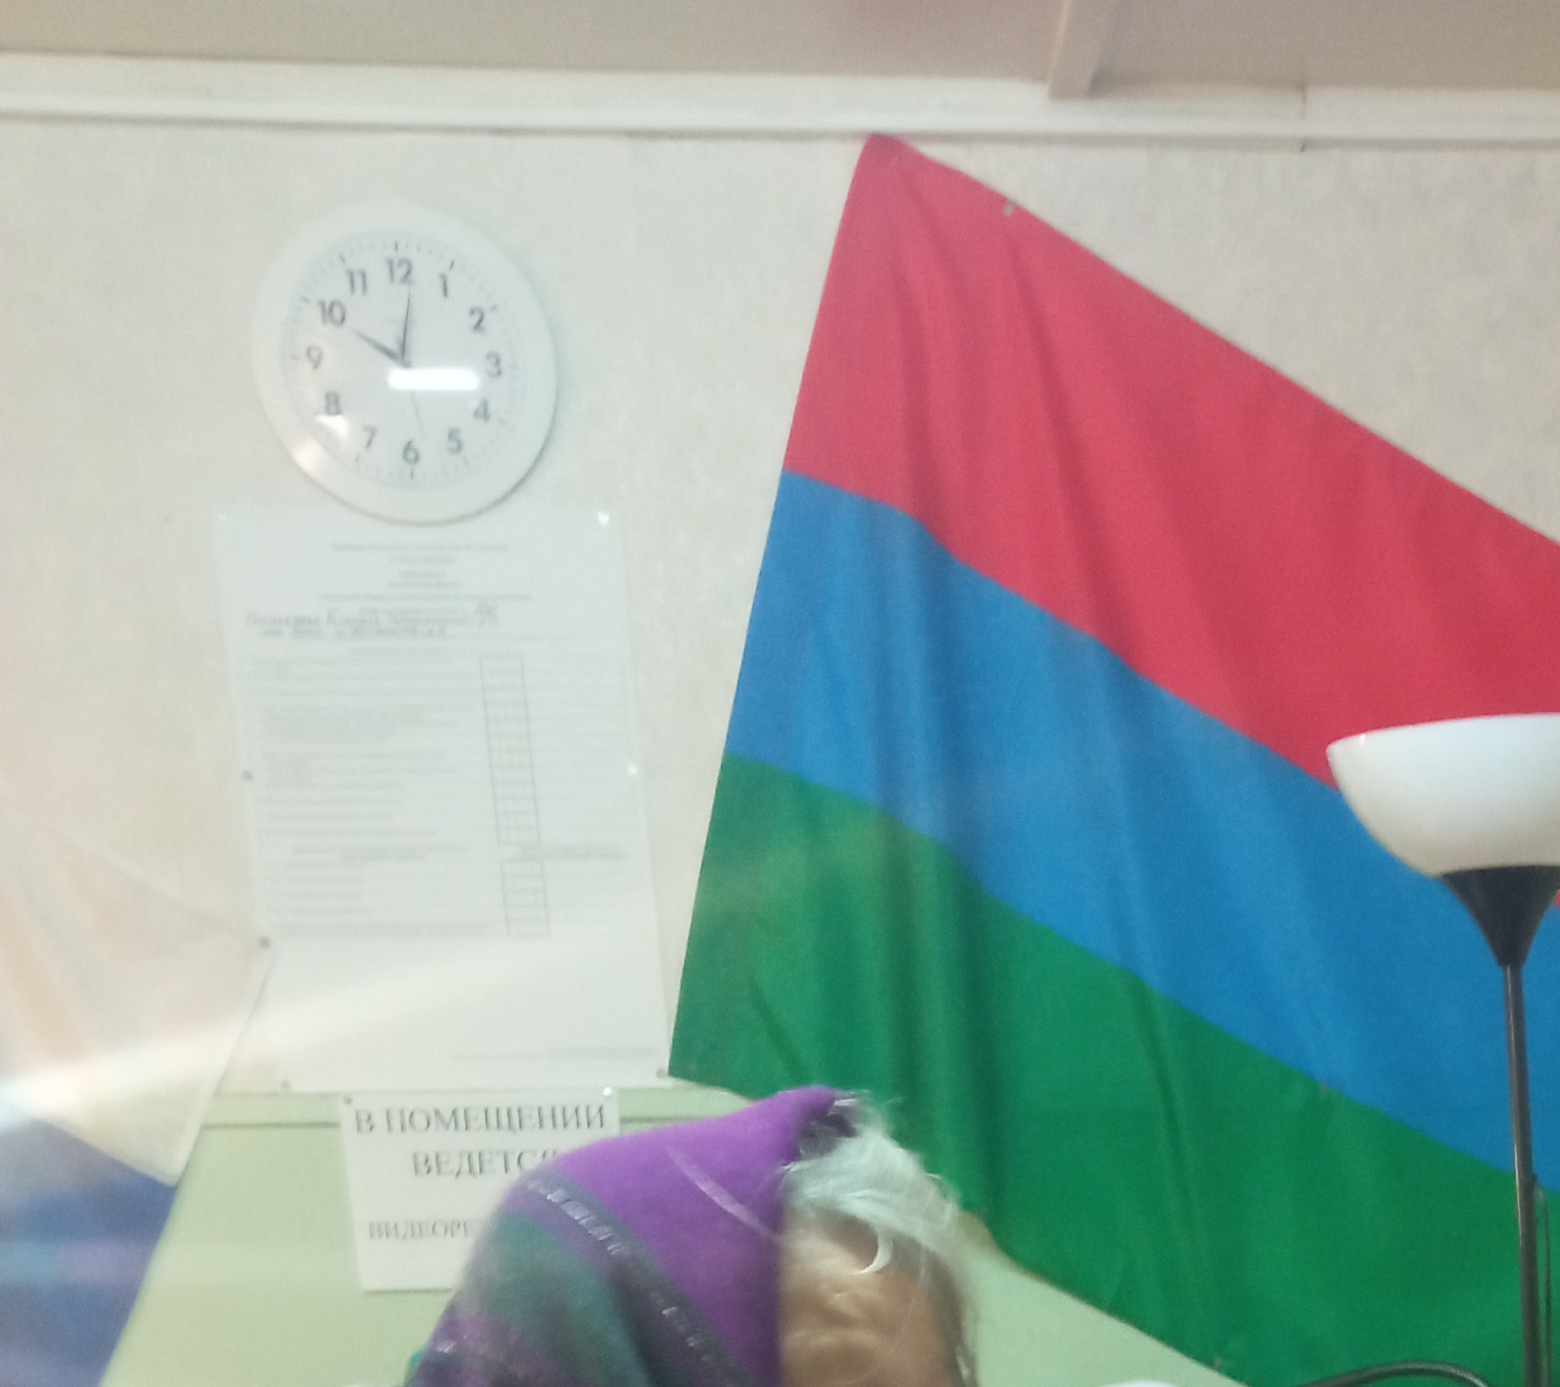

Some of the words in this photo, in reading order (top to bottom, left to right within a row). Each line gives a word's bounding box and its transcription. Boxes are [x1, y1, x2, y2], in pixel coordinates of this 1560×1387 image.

[347, 267, 367, 295] 11
[386, 257, 415, 285] 12
[440, 271, 449, 298] 1
[317, 298, 346, 328] 10
[469, 305, 486, 334] 2
[305, 344, 323, 370] 9
[485, 350, 502, 378] 3
[325, 390, 341, 416] 8
[473, 397, 491, 423] 4
[361, 424, 377, 449] 7
[447, 426, 463, 455] 5
[402, 438, 421, 465] 6
[355, 1108, 374, 1134] В
[385, 1103, 605, 1134] ПОМЕЩЕНИИ
